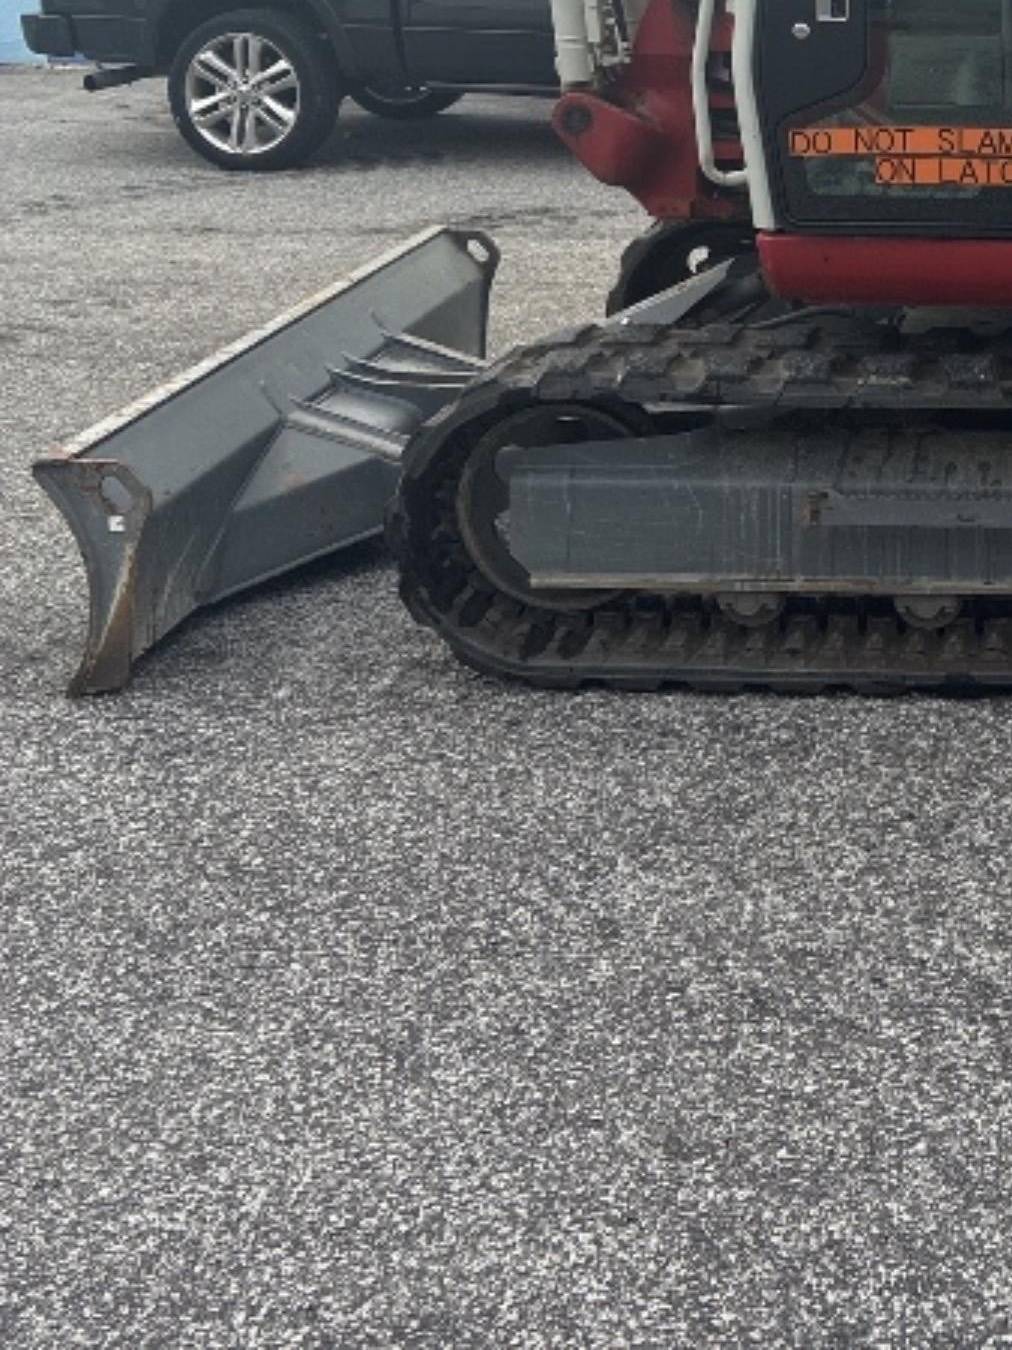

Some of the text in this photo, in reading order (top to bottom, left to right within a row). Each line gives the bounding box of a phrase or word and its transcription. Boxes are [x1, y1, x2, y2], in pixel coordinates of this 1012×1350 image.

[791, 130, 832, 154] DO
[854, 127, 914, 152] NOT
[876, 158, 916, 181] ON
